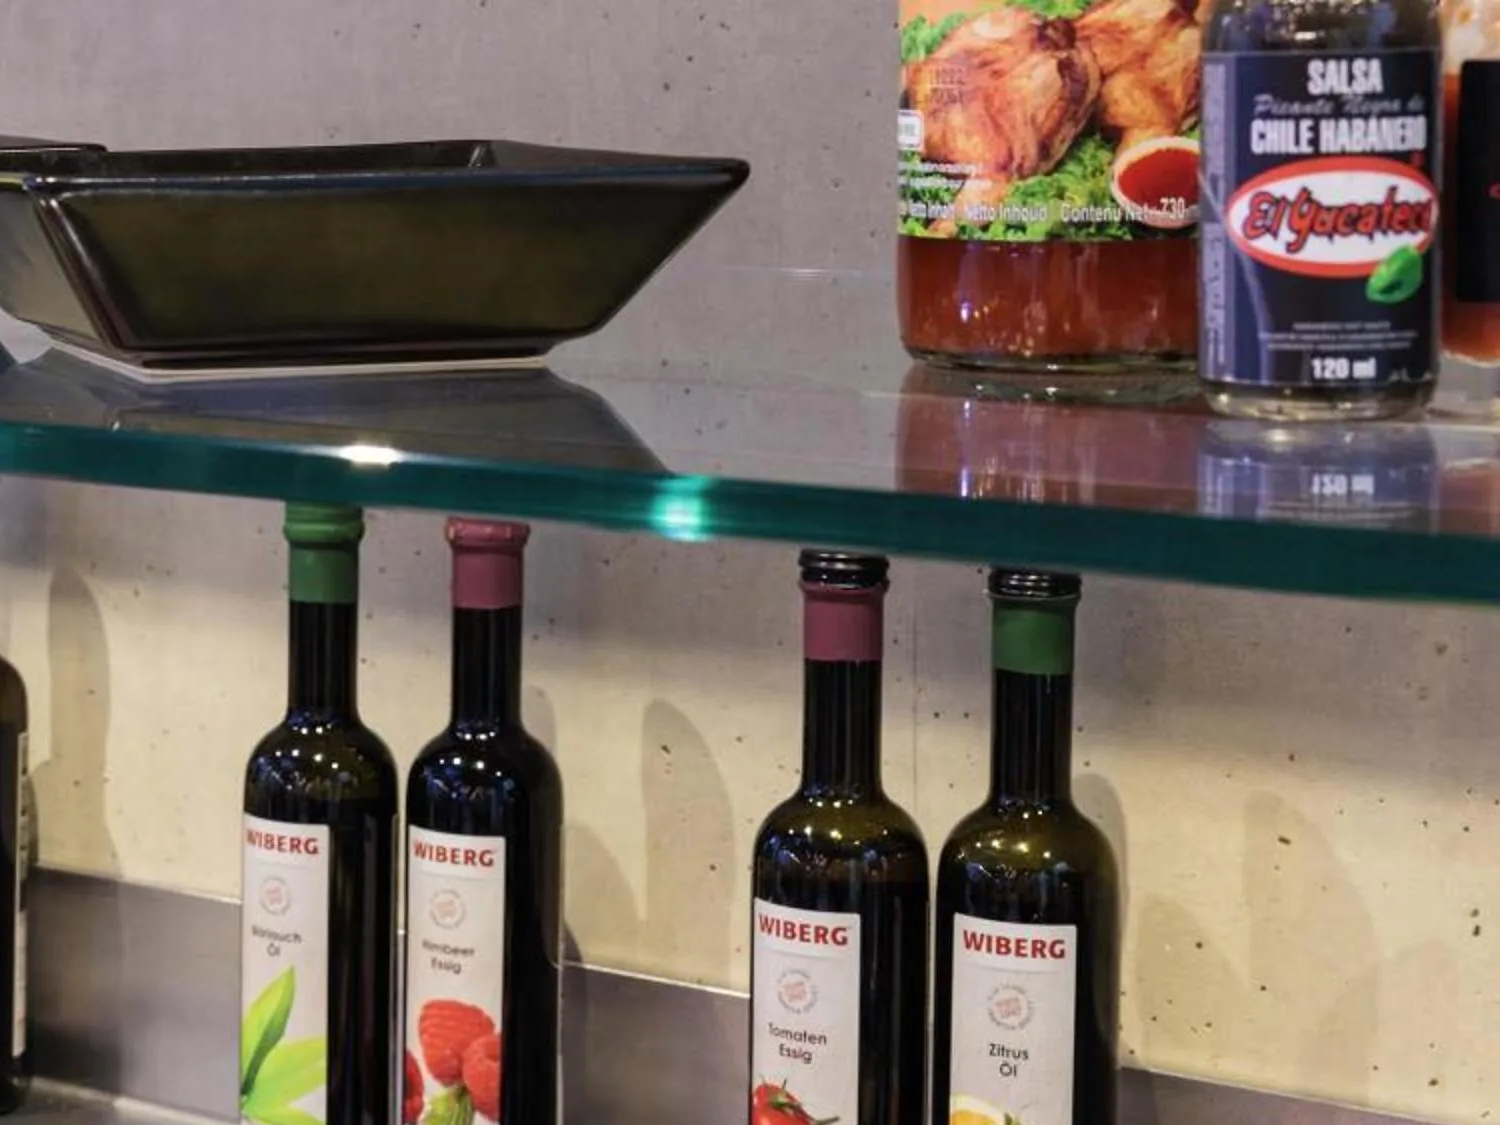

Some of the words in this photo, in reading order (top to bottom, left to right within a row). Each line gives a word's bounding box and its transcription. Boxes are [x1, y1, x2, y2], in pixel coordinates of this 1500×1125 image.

[1307, 57, 1384, 95] SALSA
[1251, 117, 1314, 154] CHILE
[1310, 357, 1349, 380] 120
[1352, 356, 1377, 379] ml
[246, 828, 319, 856] WIBERG
[412, 839, 496, 868] WIBERG
[757, 912, 849, 946] WIBERG
[962, 928, 1067, 960] WIBERG
[767, 1021, 828, 1046] Tomaten
[778, 1043, 813, 1065] Essig
[988, 1042, 1029, 1062] Zitrus
